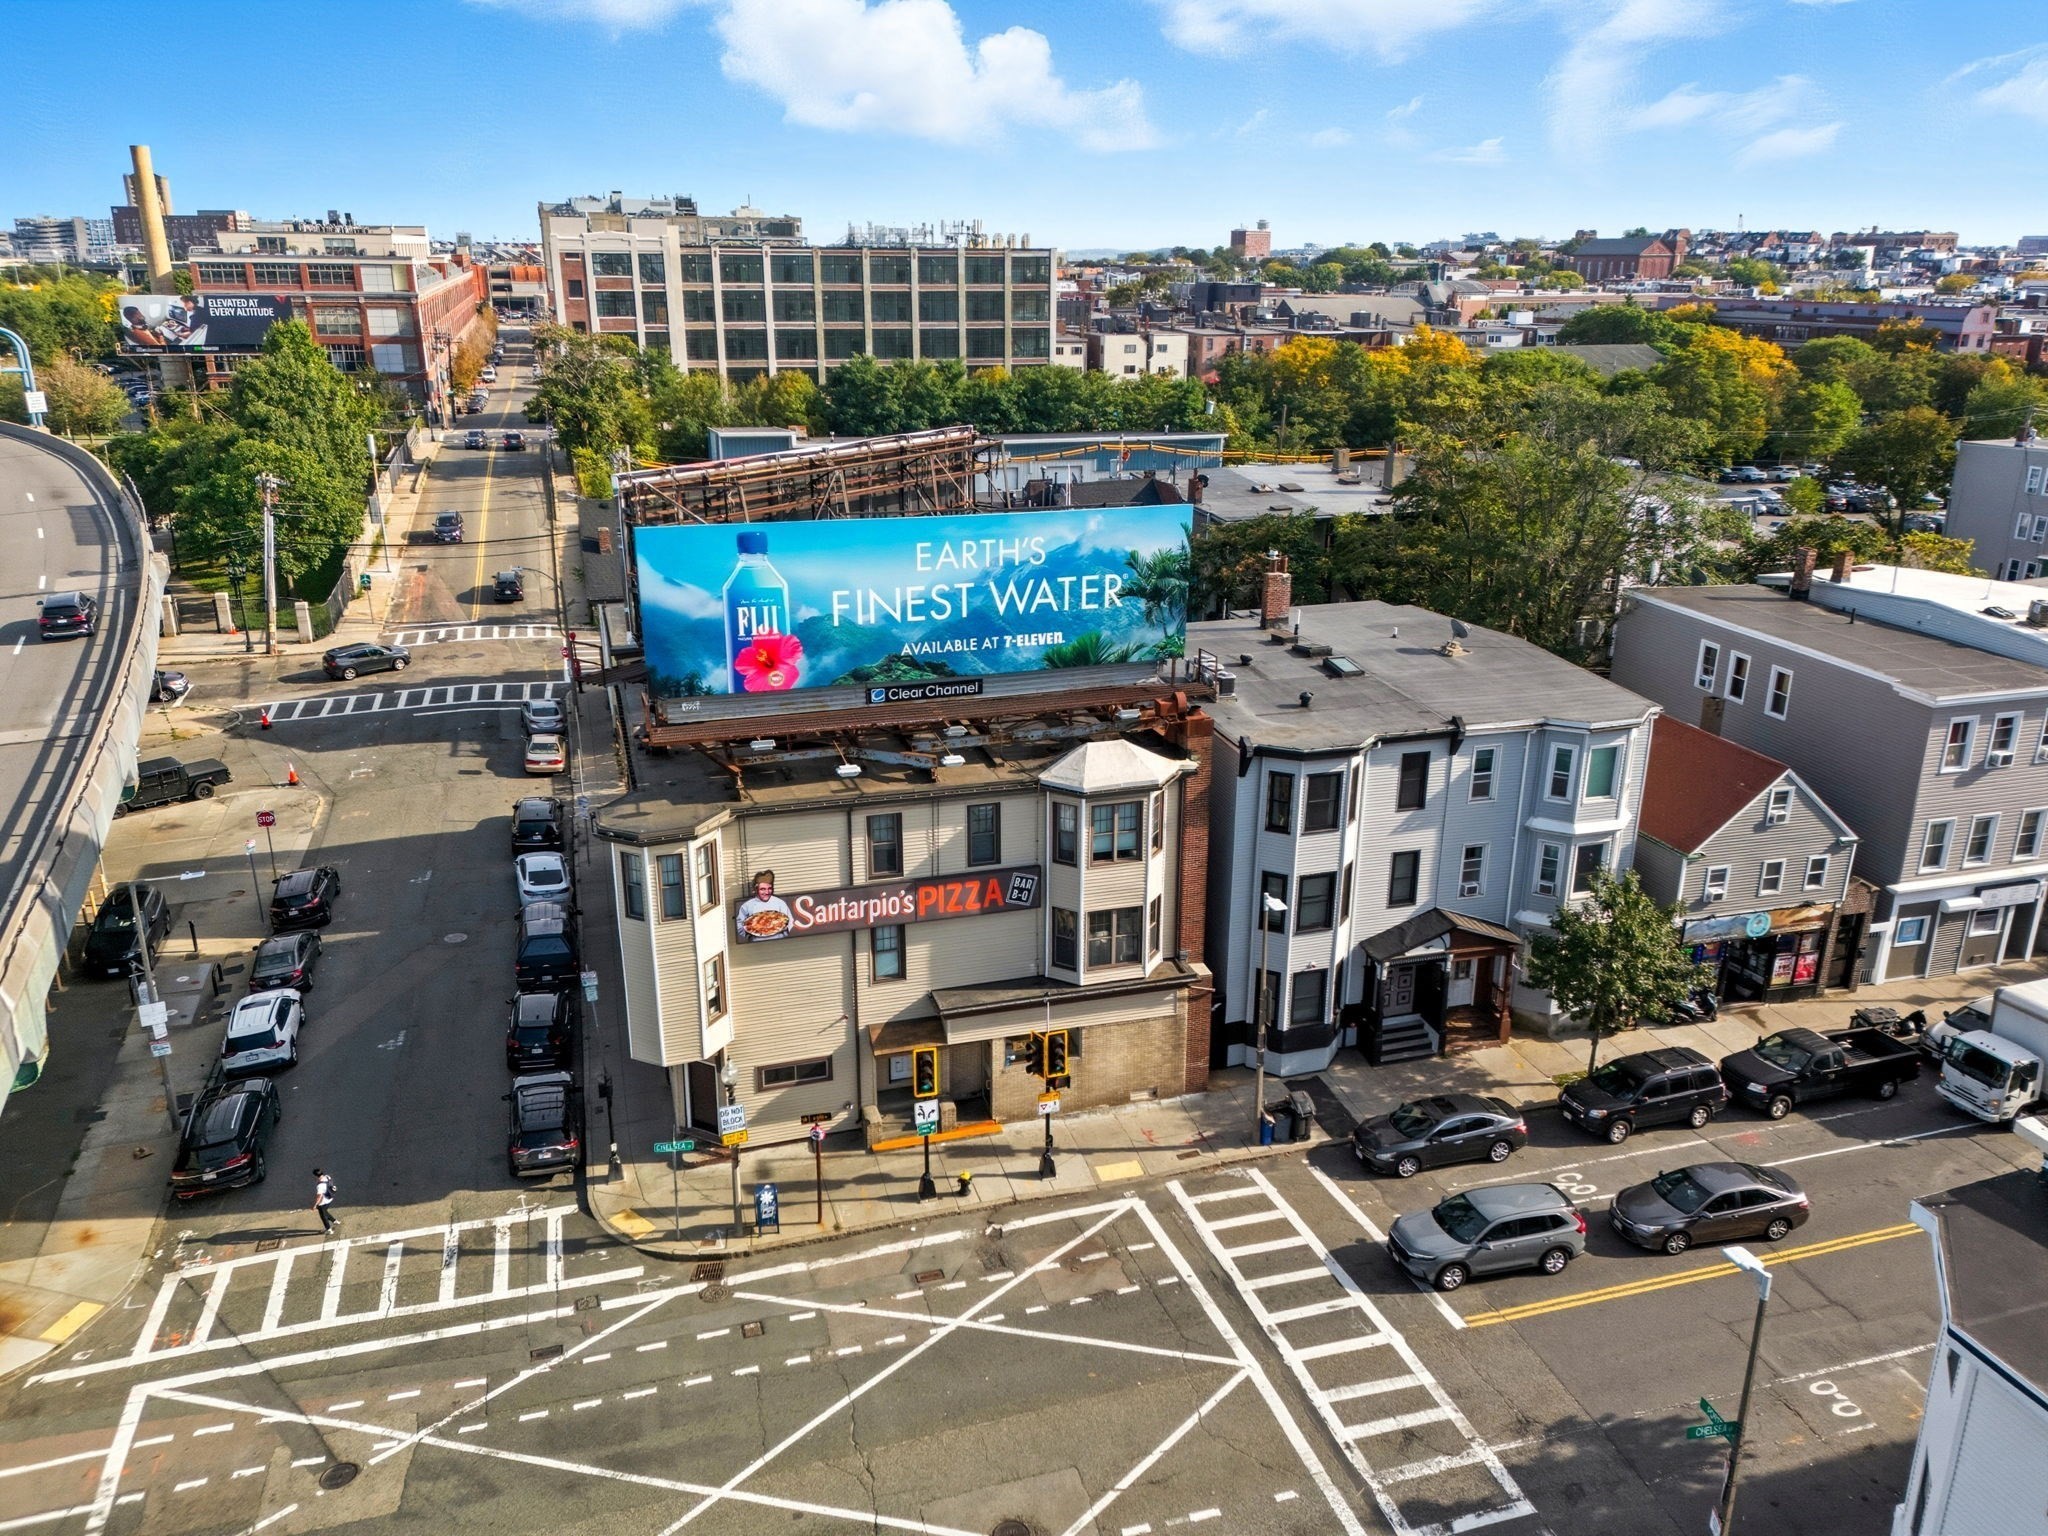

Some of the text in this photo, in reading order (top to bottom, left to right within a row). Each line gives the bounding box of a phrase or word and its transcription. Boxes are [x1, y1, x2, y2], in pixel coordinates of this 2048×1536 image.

[208, 298, 258, 308] ELEVATED AT
[210, 308, 275, 316] EVERY ALTITUDE
[915, 536, 1047, 572] EARTH'S
[832, 573, 1123, 627] FINEST WATER
[736, 605, 780, 637] FIJI
[901, 638, 978, 656] AVAILABLE
[982, 636, 999, 650] AT
[888, 681, 979, 701] Clear Channel
[1014, 877, 1033, 889] BAR
[793, 877, 1004, 929] Santarpio's PIZZA
